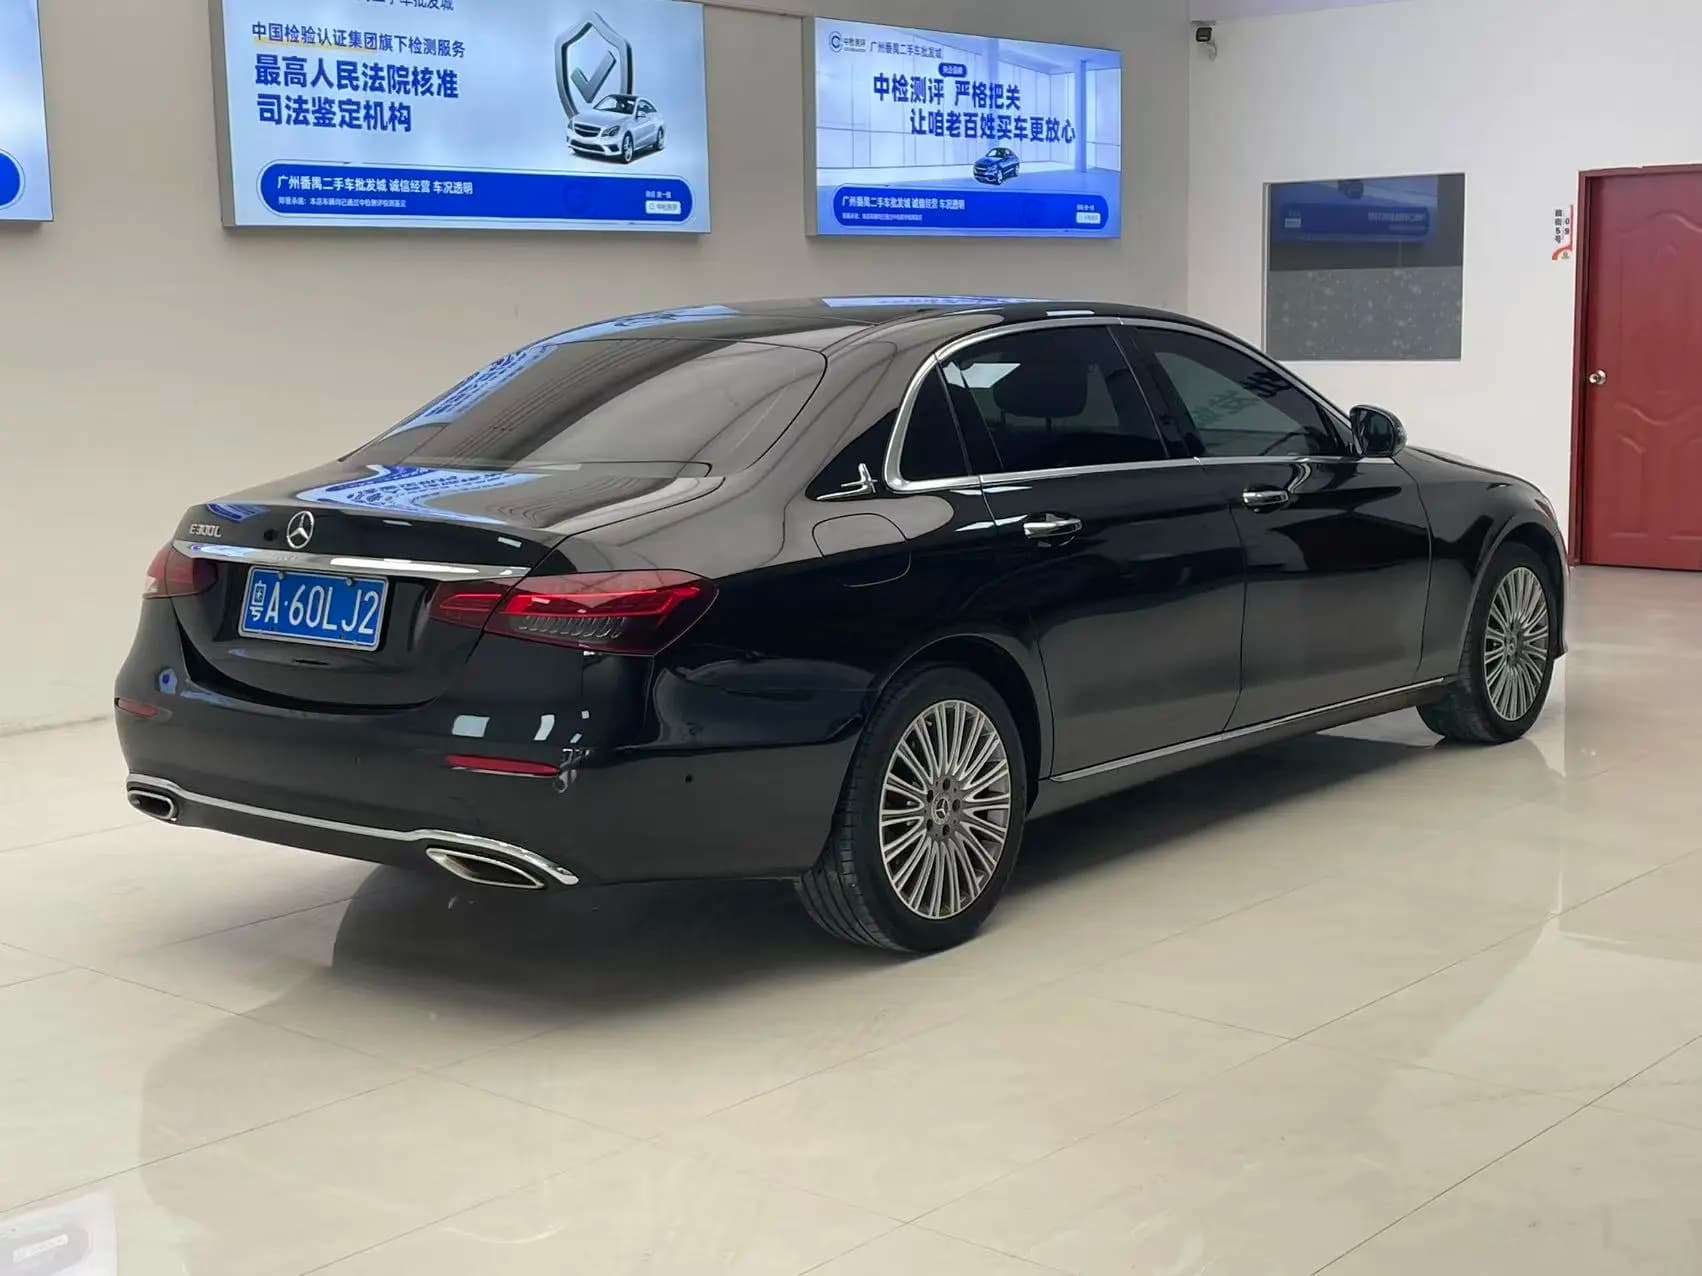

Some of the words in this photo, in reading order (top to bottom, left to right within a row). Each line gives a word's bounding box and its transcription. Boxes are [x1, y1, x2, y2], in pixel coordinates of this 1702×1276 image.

[252, 21, 465, 58] 中国检验认证集团旗下检测服务
[254, 53, 460, 99] 最高人民法院核准
[873, 72, 945, 105] 中检测评
[954, 80, 1021, 111] 严格把关
[256, 93, 413, 132] 司法鉴定机构
[910, 109, 1076, 144] 让咱老百姓买车更放心
[277, 175, 388, 193] 广州番禺二手车批发城
[389, 178, 431, 193] 诚信经营
[433, 181, 474, 195] 车况透明
[189, 523, 222, 538] E300L
